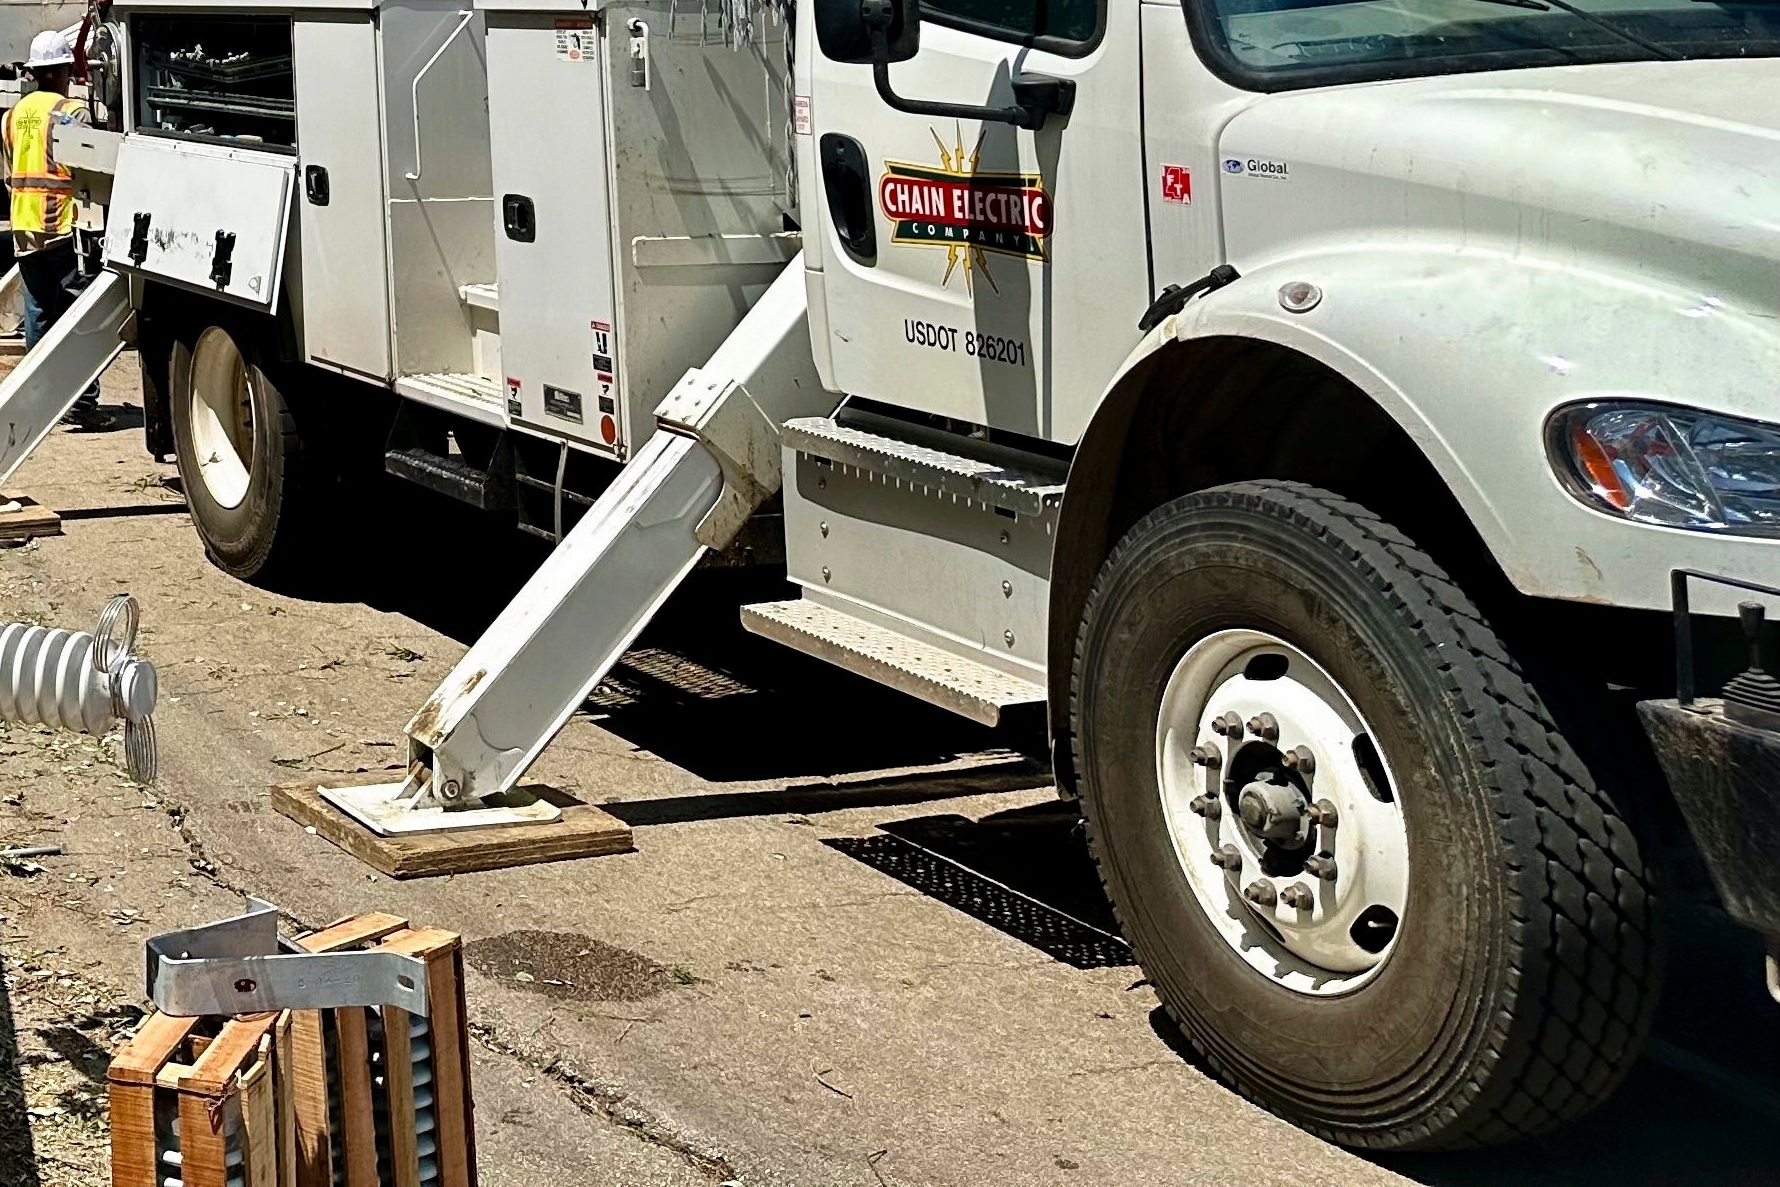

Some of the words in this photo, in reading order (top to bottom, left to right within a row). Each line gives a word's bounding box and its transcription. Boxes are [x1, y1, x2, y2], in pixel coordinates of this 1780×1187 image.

[1247, 159, 1288, 174] Global
[884, 182, 945, 217] CHAIN
[952, 189, 1045, 229] ELECTRIC
[912, 223, 1020, 247] COMPANY
[904, 319, 958, 352] USDOT
[965, 331, 1025, 366] 826201
